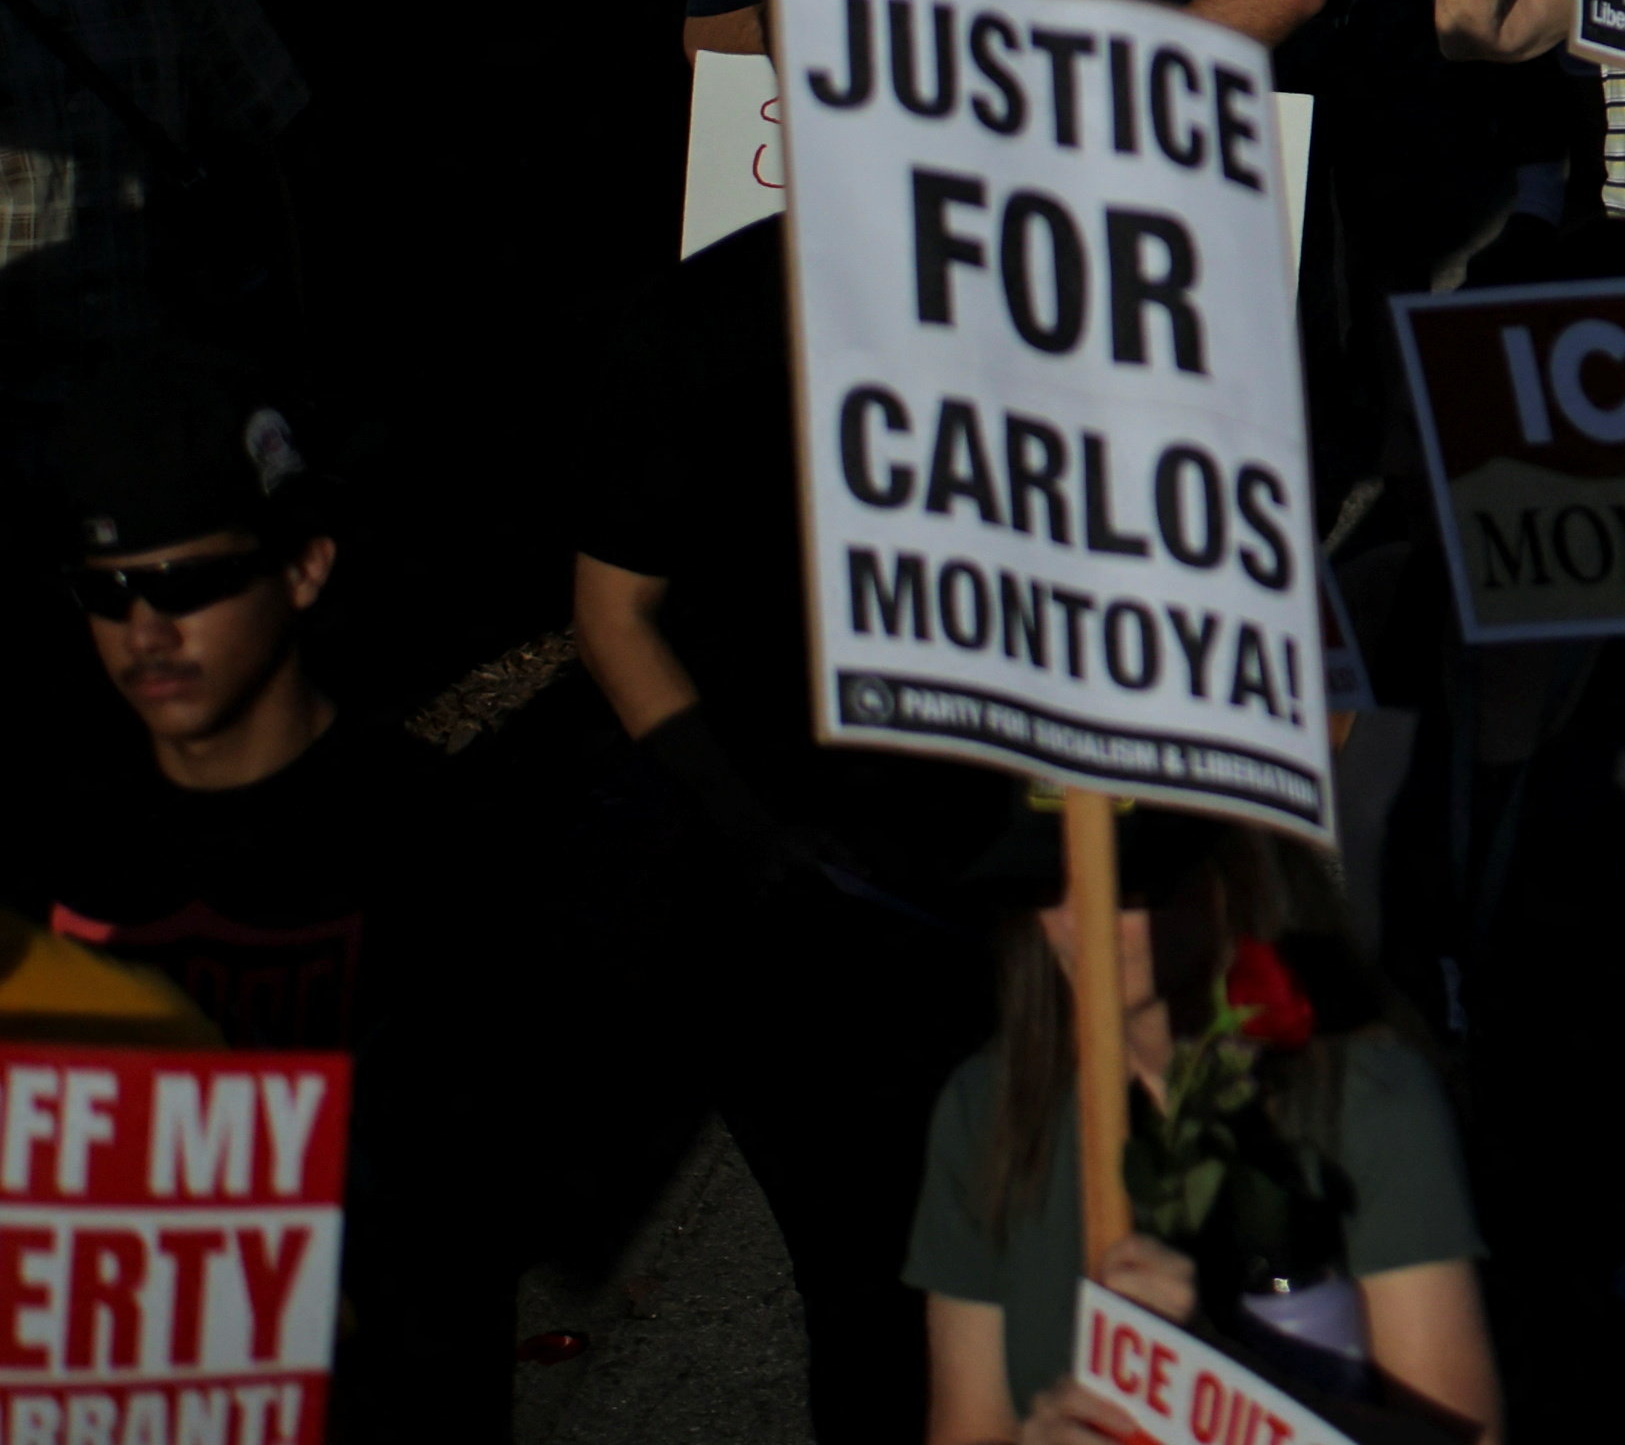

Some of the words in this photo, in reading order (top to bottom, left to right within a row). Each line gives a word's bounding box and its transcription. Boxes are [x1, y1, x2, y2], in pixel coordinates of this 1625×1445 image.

[911, 165, 1209, 377] FOR
[839, 383, 1292, 592] CARLOS
[847, 545, 1304, 726] MONTOYA!
